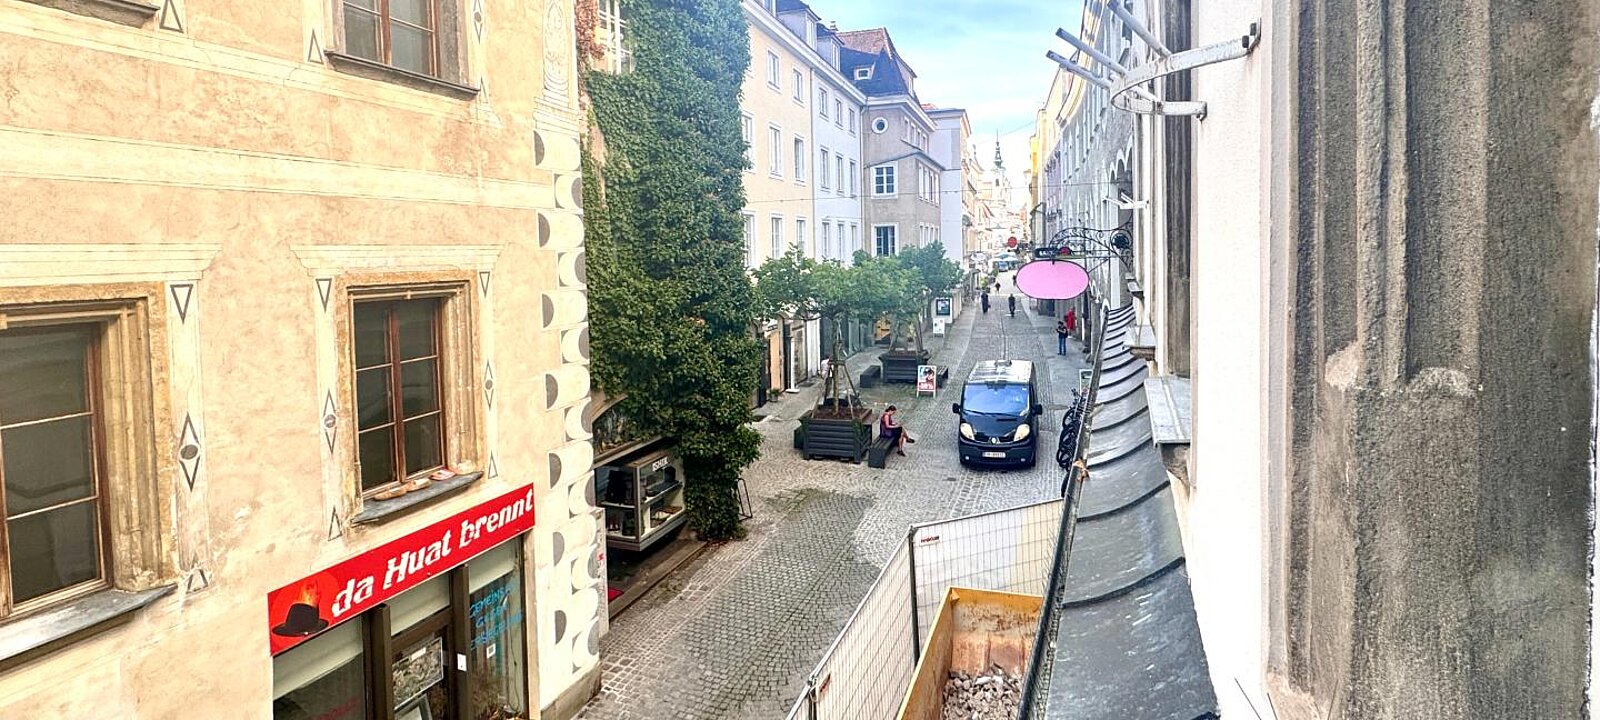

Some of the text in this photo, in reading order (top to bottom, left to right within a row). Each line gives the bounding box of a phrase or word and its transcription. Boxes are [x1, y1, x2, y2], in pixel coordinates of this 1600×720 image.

[331, 488, 533, 618] da Huat brennt
